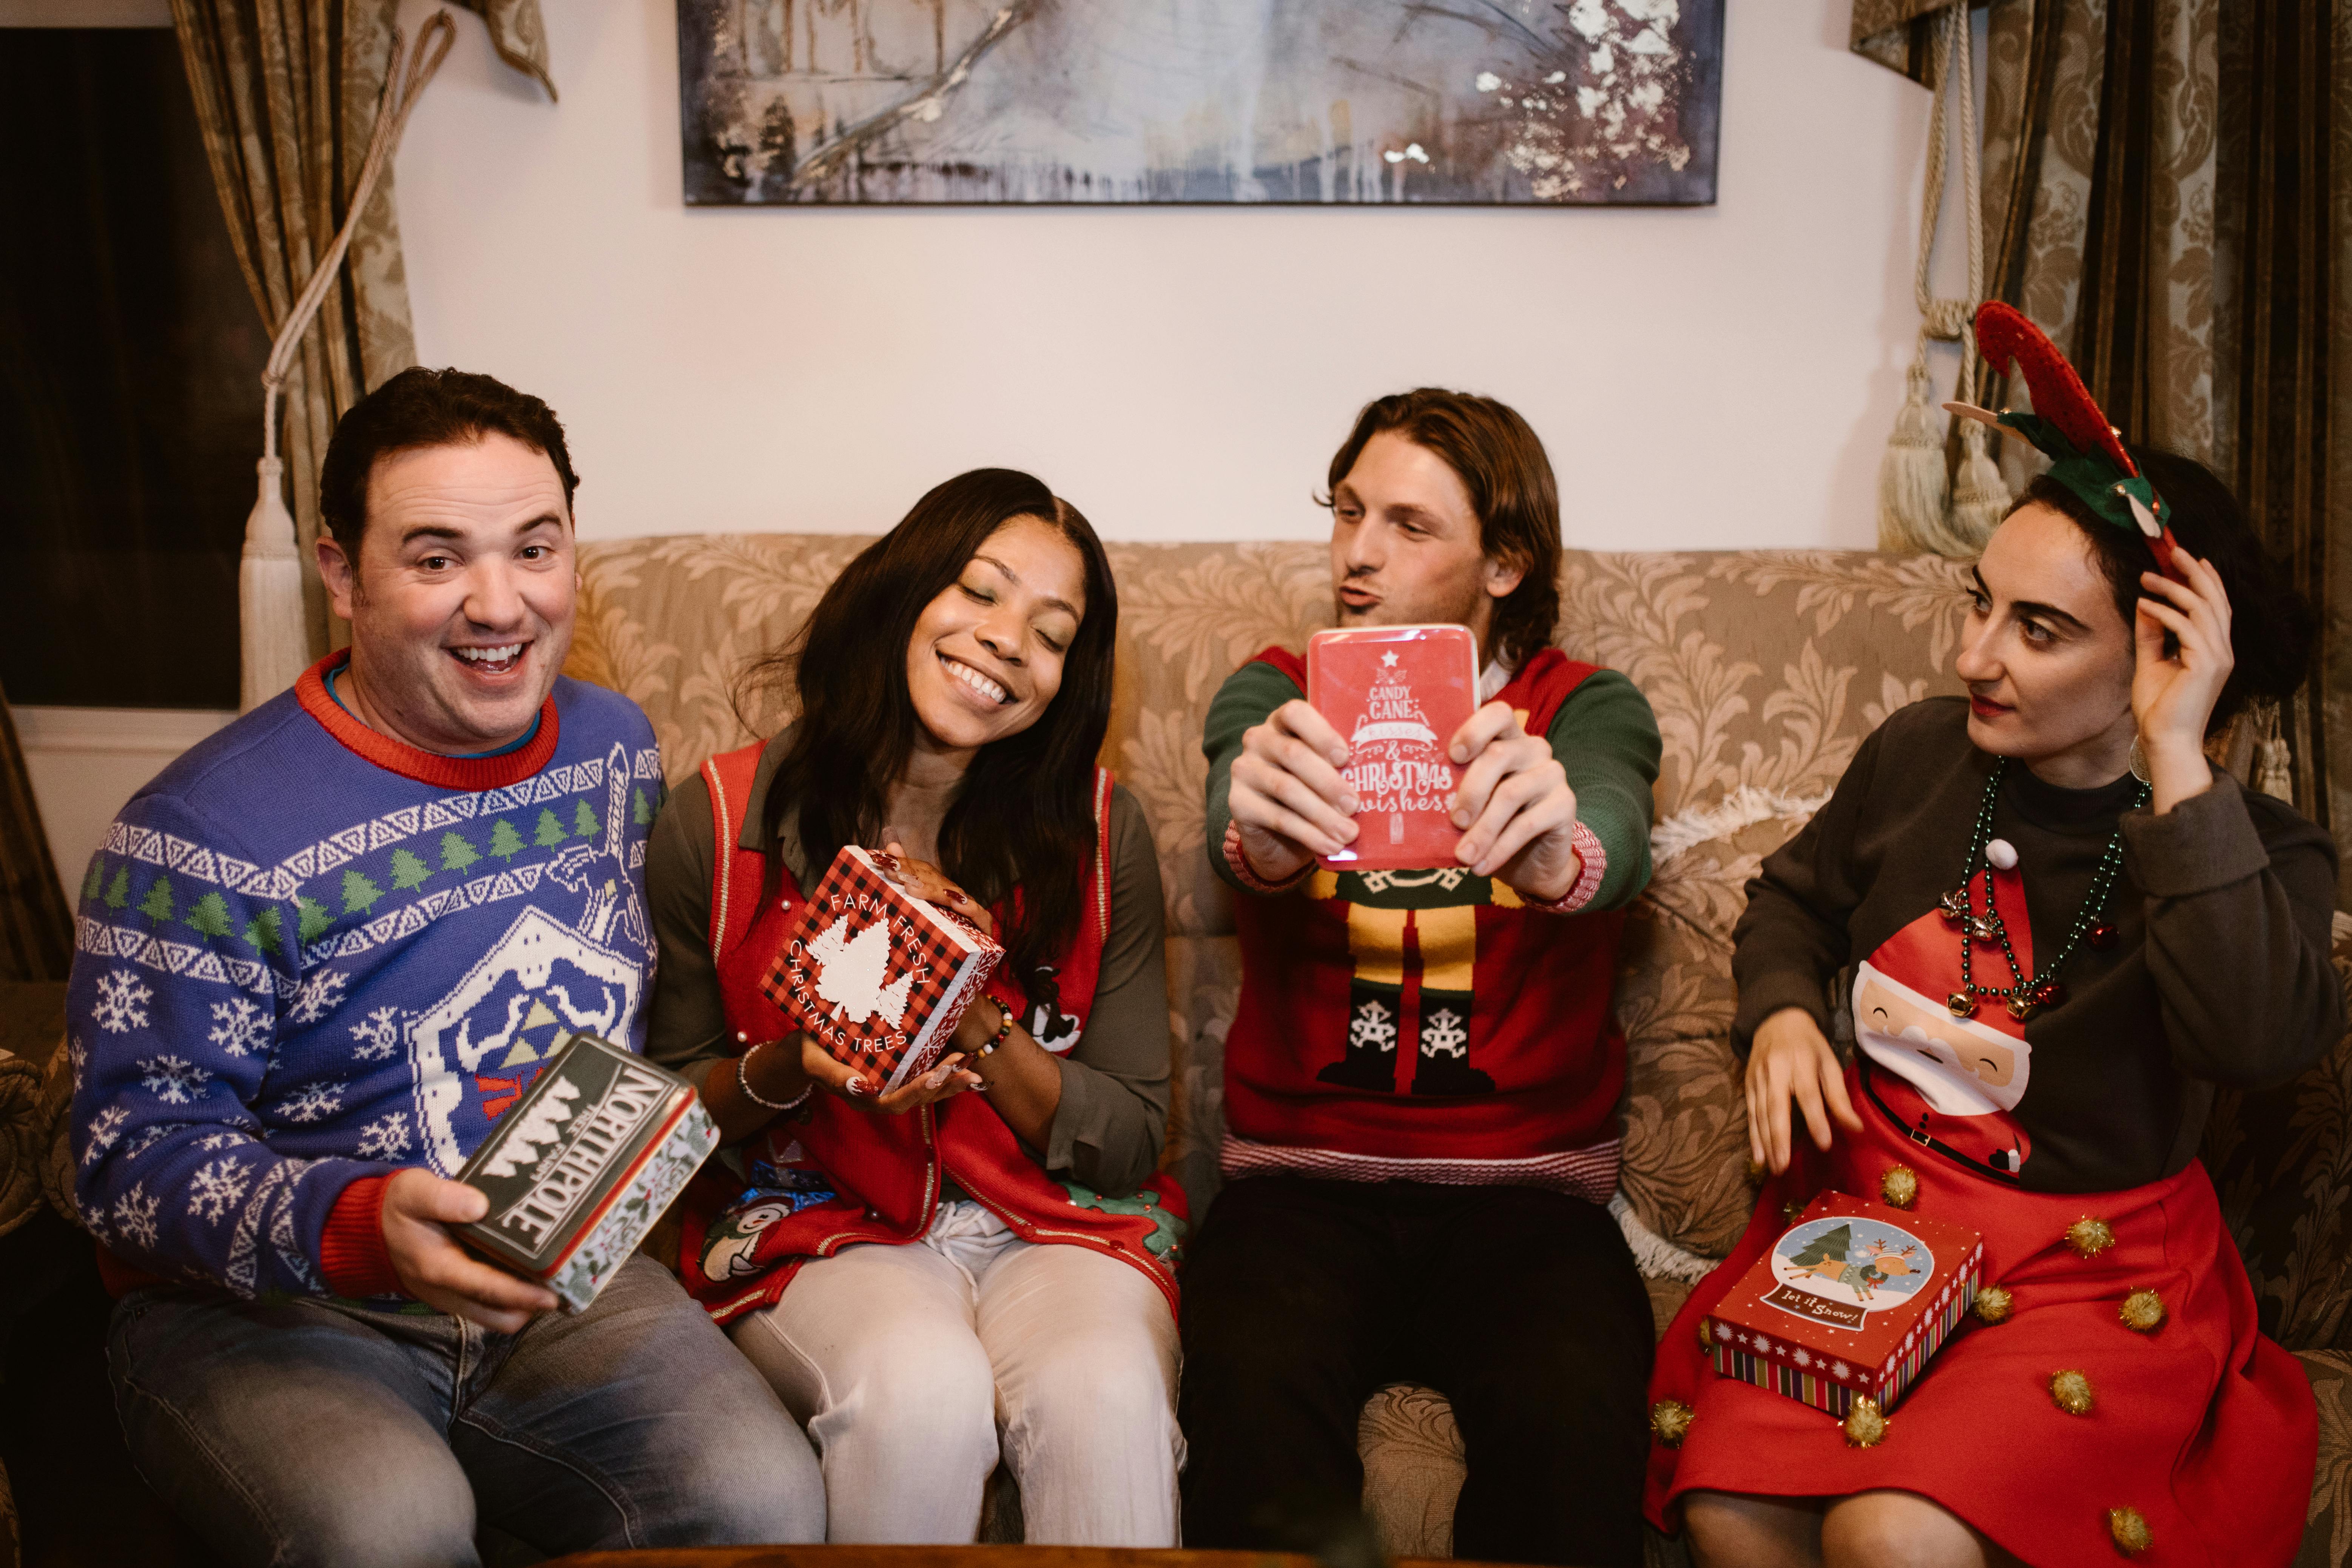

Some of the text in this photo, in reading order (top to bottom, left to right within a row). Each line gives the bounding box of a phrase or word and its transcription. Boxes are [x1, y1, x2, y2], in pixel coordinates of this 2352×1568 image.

[1369, 686, 1411, 700] CANDY
[1370, 700, 1413, 719] CANE
[1368, 726, 1422, 739] kisses
[1385, 740, 1400, 761] &
[831, 893, 930, 984] FARM FRESH
[790, 940, 907, 1052] CHRISTMAS TREES
[530, 1103, 597, 1183] TREE FARM
[1803, 1297, 1818, 1307] it
[1812, 1305, 1858, 1320] Snow!
